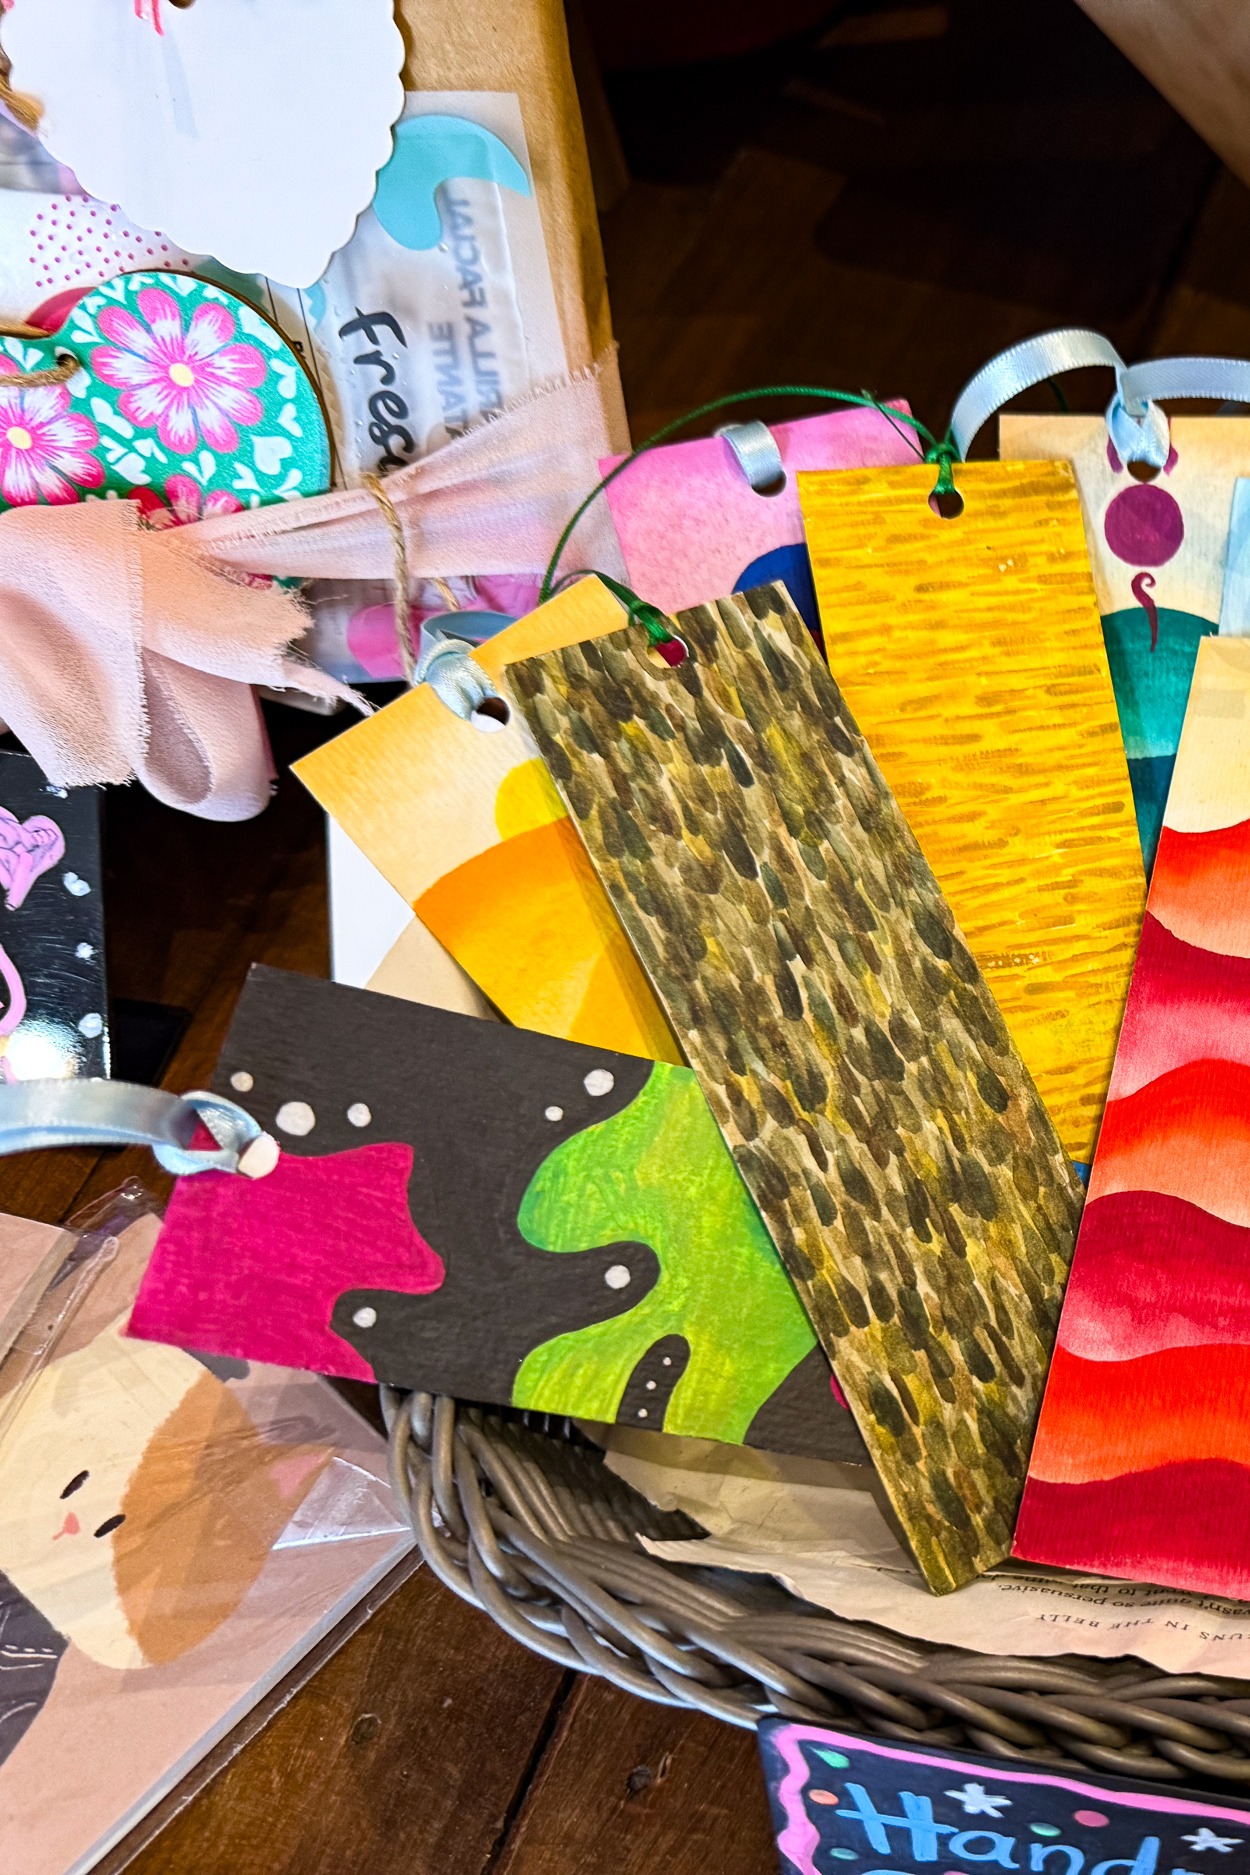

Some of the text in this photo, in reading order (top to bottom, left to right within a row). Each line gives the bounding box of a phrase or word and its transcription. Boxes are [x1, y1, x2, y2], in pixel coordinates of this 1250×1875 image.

[998, 1584, 1109, 1606] persuasive.
[1118, 1589, 1136, 1597] to
[1035, 1614, 1100, 1628] BELLY
[1164, 1620, 1189, 1631] IN
[835, 1782, 1194, 1875] Hand
